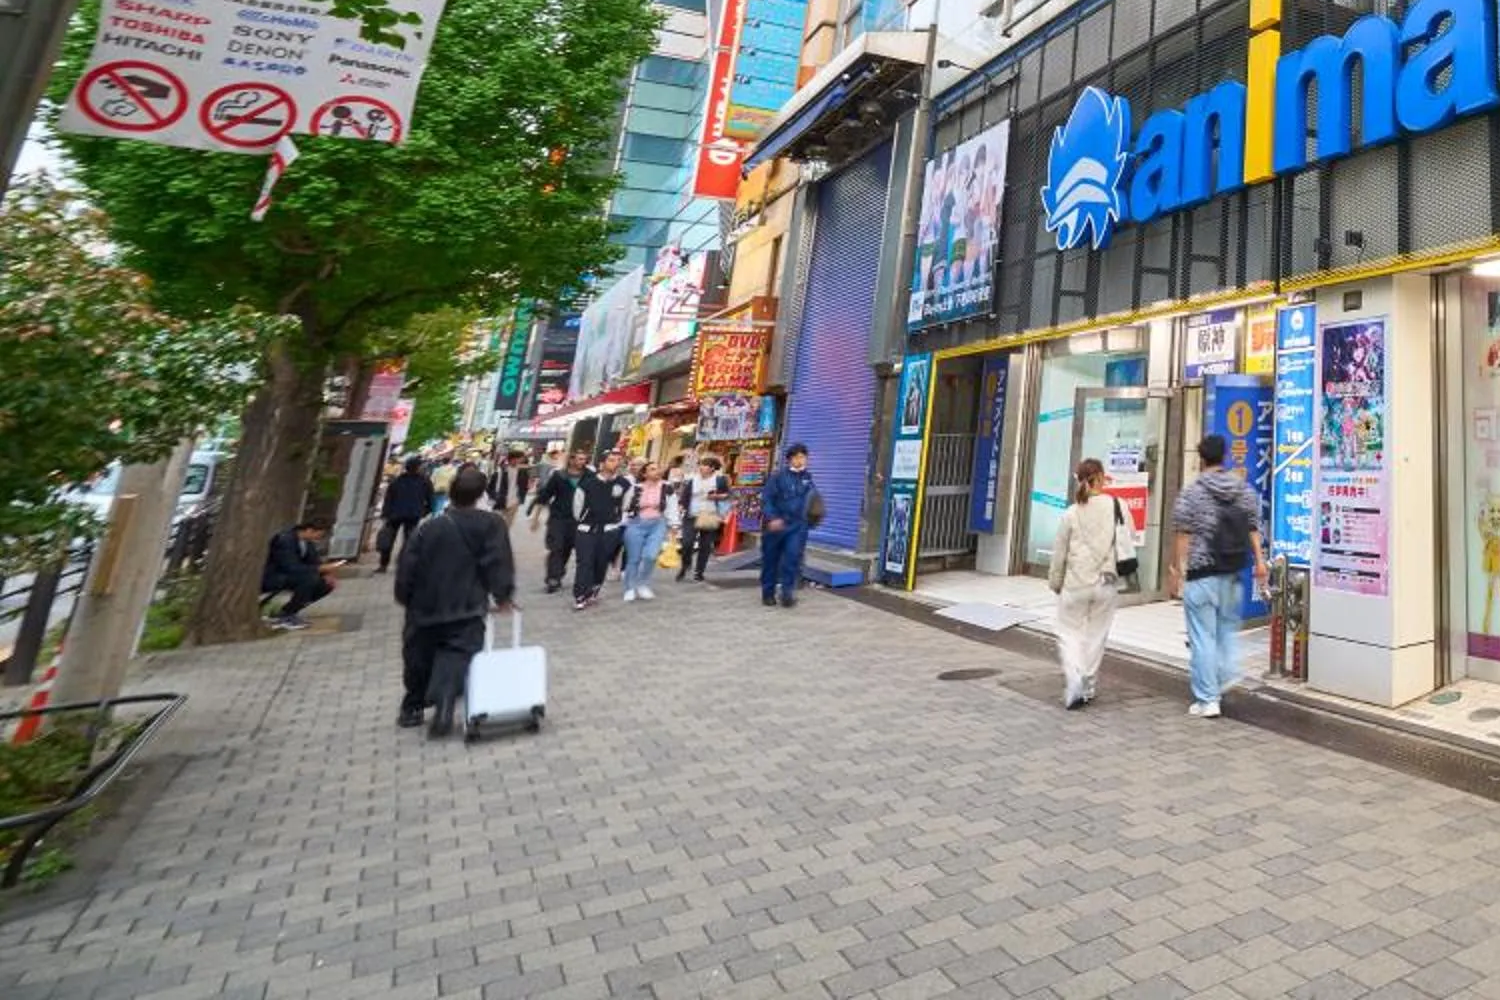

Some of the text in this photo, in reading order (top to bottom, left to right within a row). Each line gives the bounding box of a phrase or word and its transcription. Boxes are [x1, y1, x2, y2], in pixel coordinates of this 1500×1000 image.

[114, 0, 212, 26] SHARP
[109, 15, 205, 45] TOSHIBA
[233, 25, 315, 45] SONY
[101, 32, 203, 62] HITACHI
[226, 39, 305, 61] DENON
[327, 53, 411, 78] Panasonic
